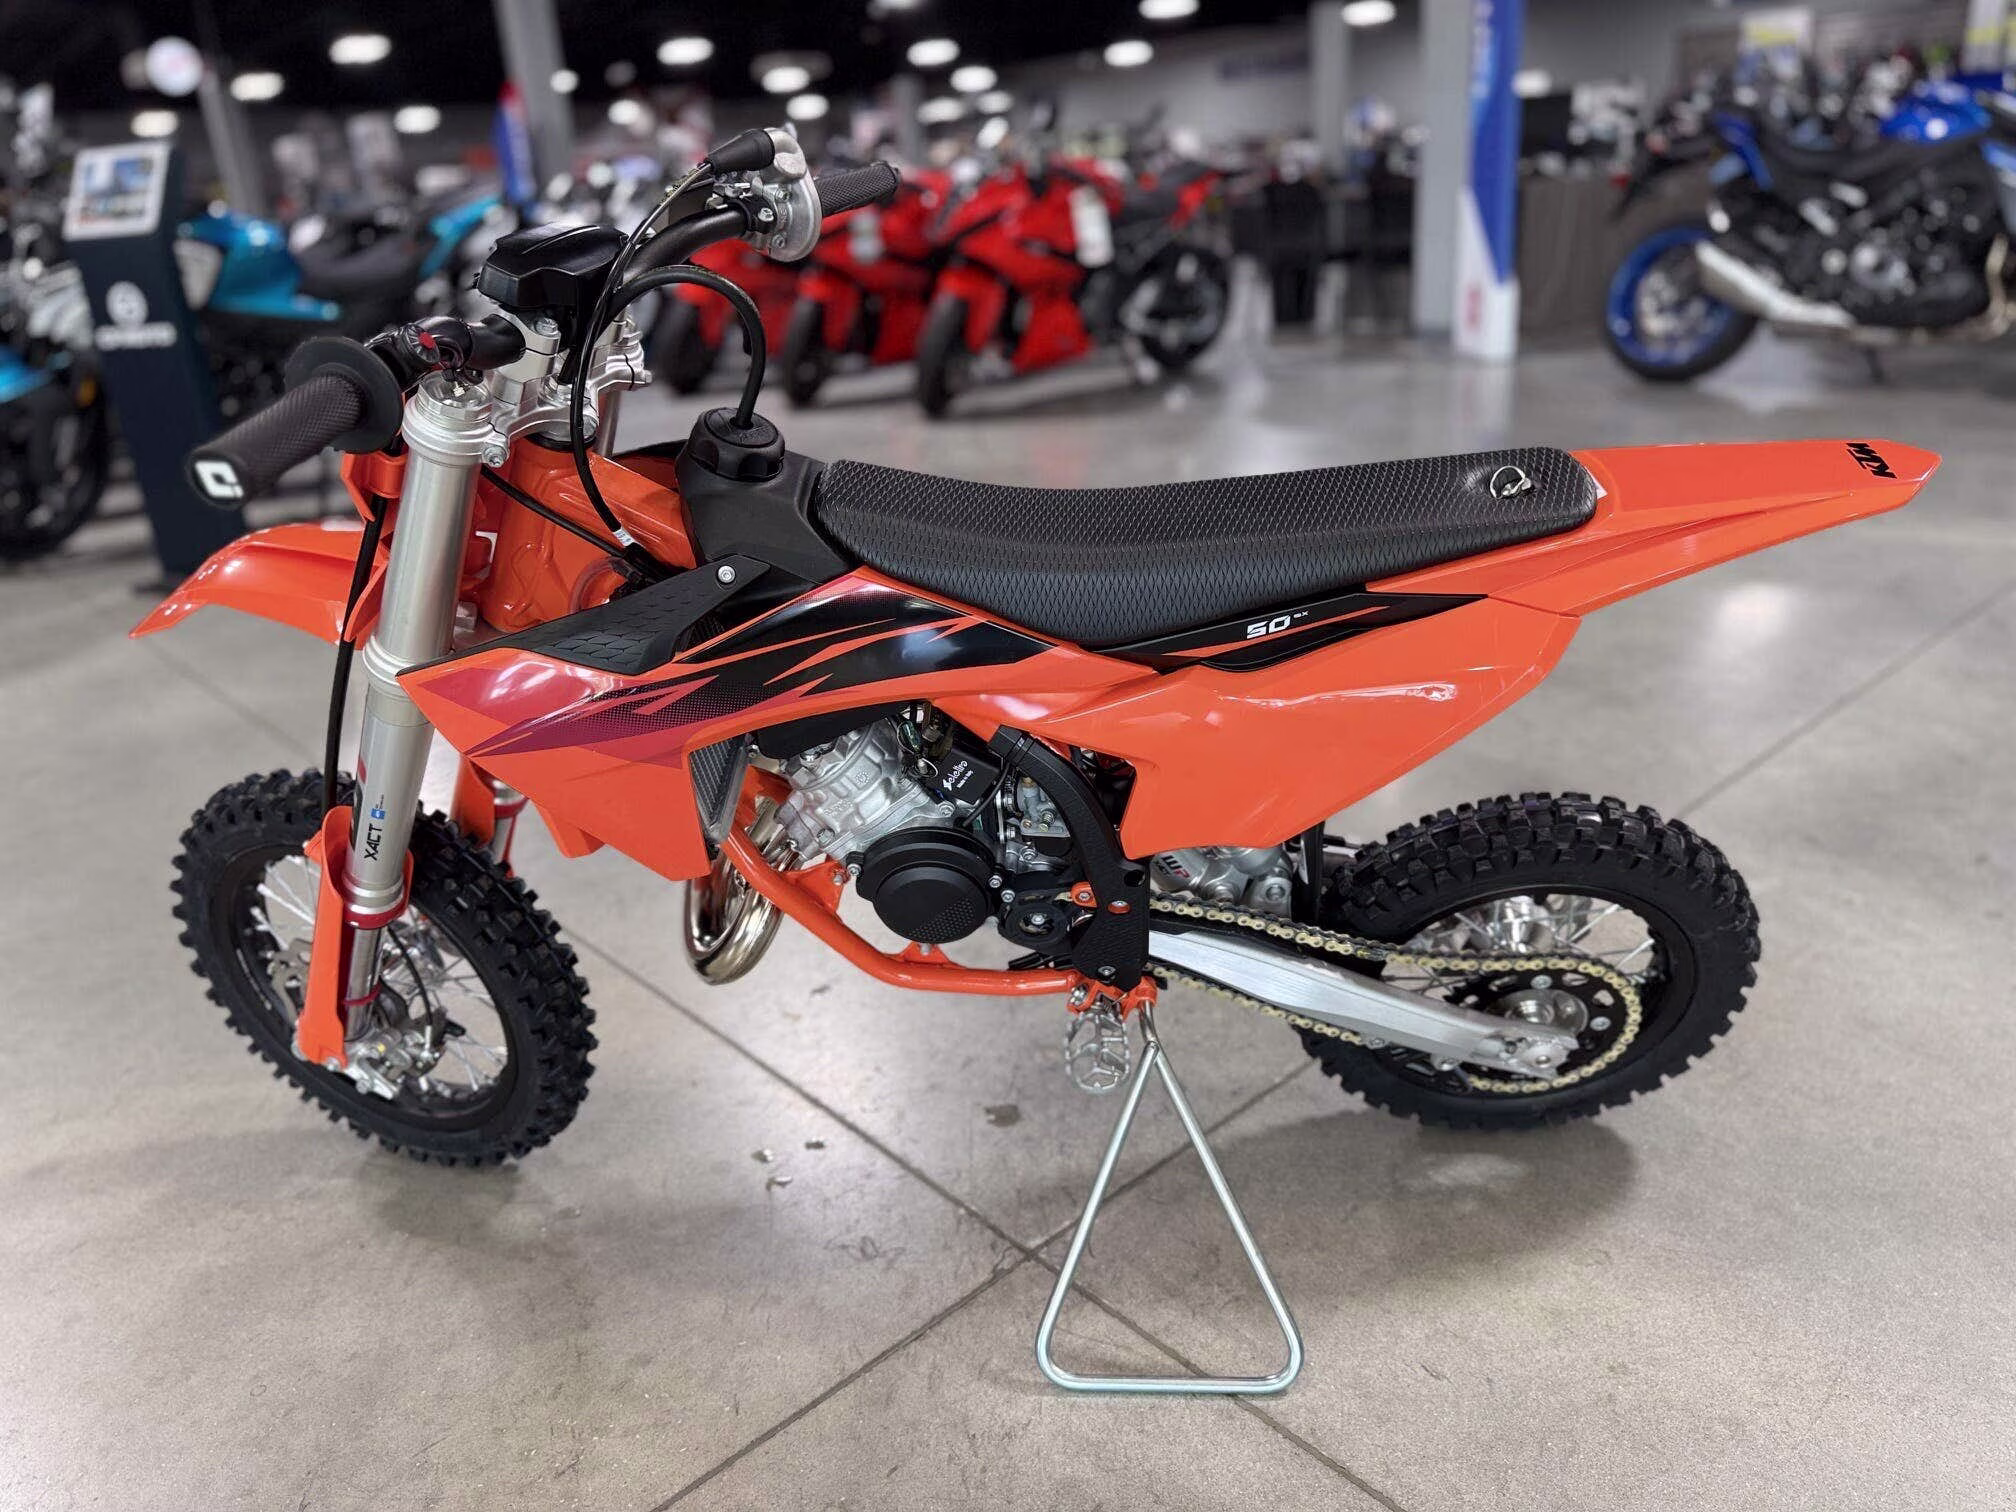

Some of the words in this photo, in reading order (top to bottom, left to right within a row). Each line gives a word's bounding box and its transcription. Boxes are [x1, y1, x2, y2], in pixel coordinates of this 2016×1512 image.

[1846, 442, 1897, 479] KTM
[1246, 615, 1291, 640] 50
[364, 822, 383, 861] XACT
